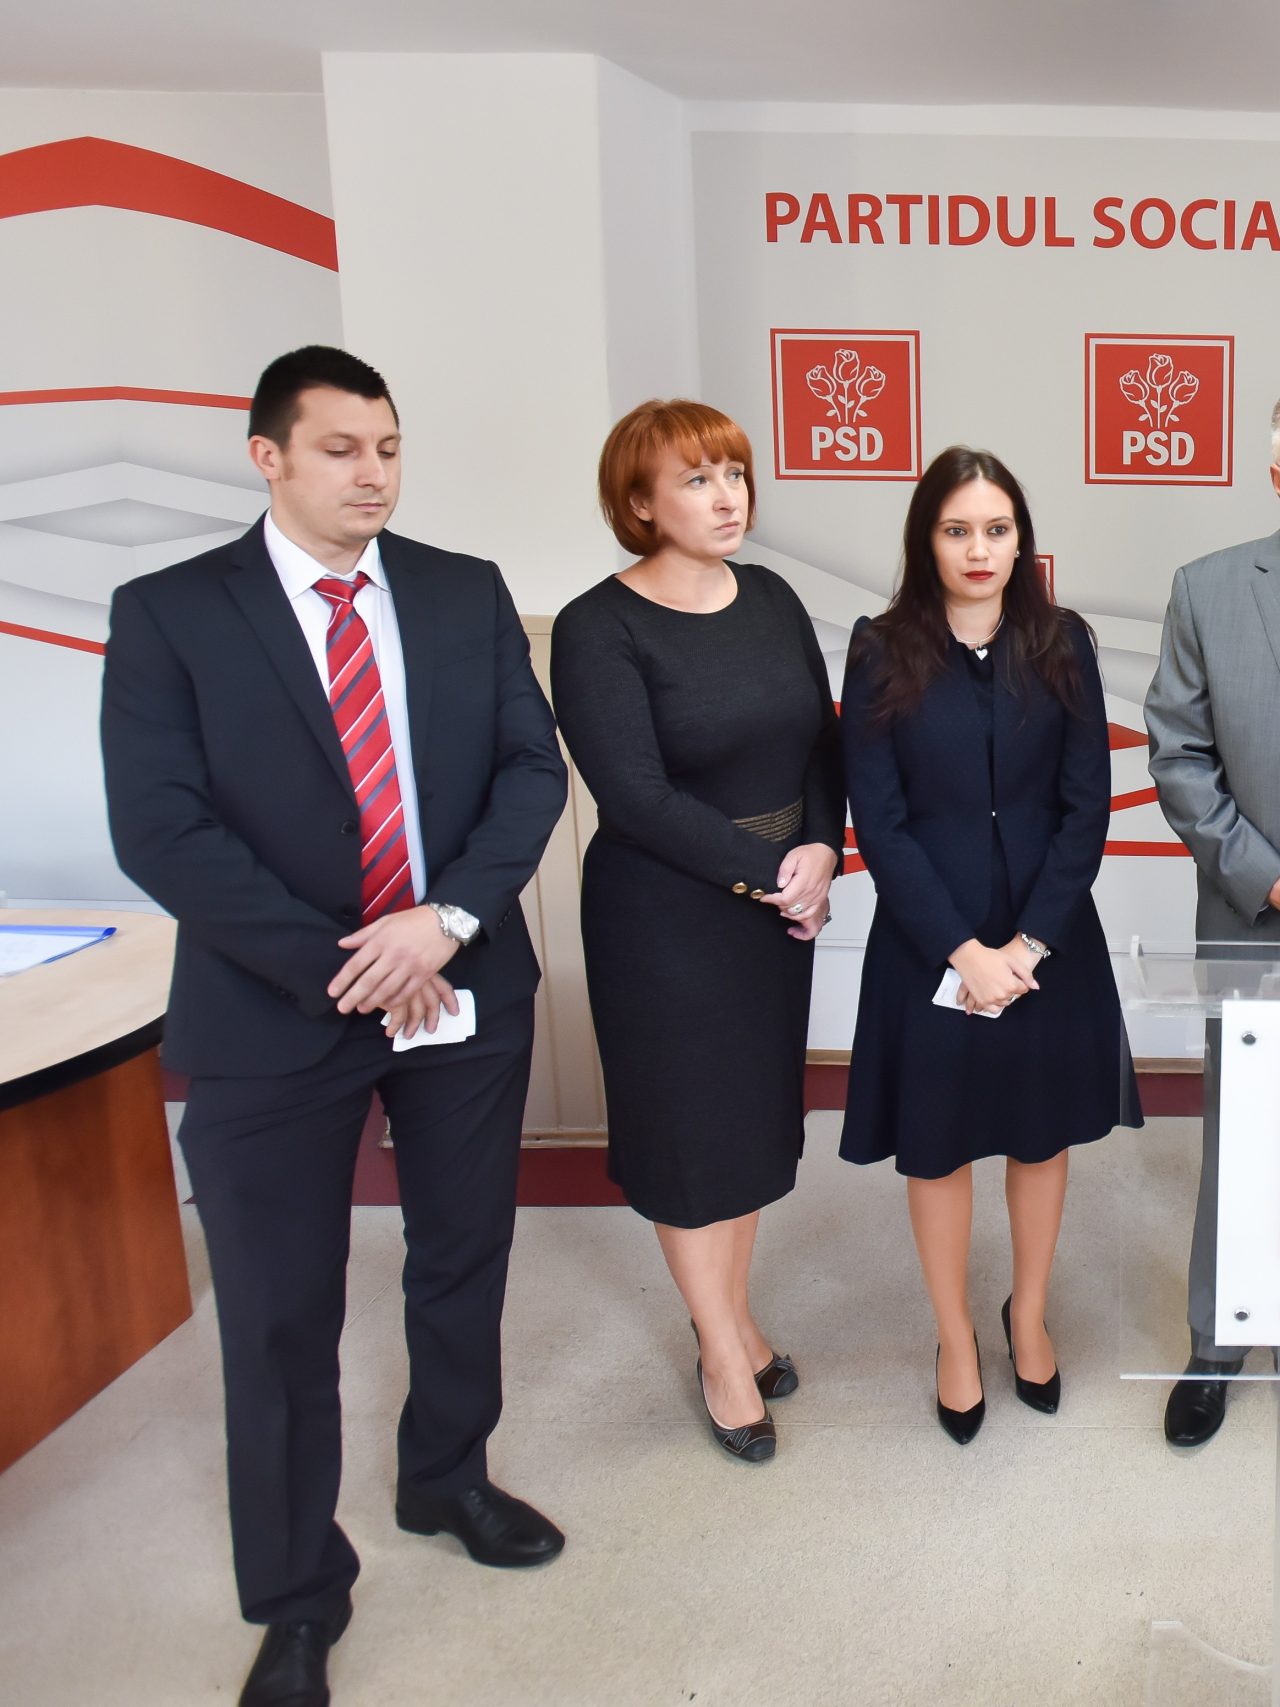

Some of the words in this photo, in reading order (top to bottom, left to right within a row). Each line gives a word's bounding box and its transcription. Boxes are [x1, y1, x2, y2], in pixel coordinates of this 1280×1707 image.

[765, 192, 1075, 247] PARTIDUL
[811, 425, 884, 462] PSD
[1122, 430, 1196, 467] PSD
